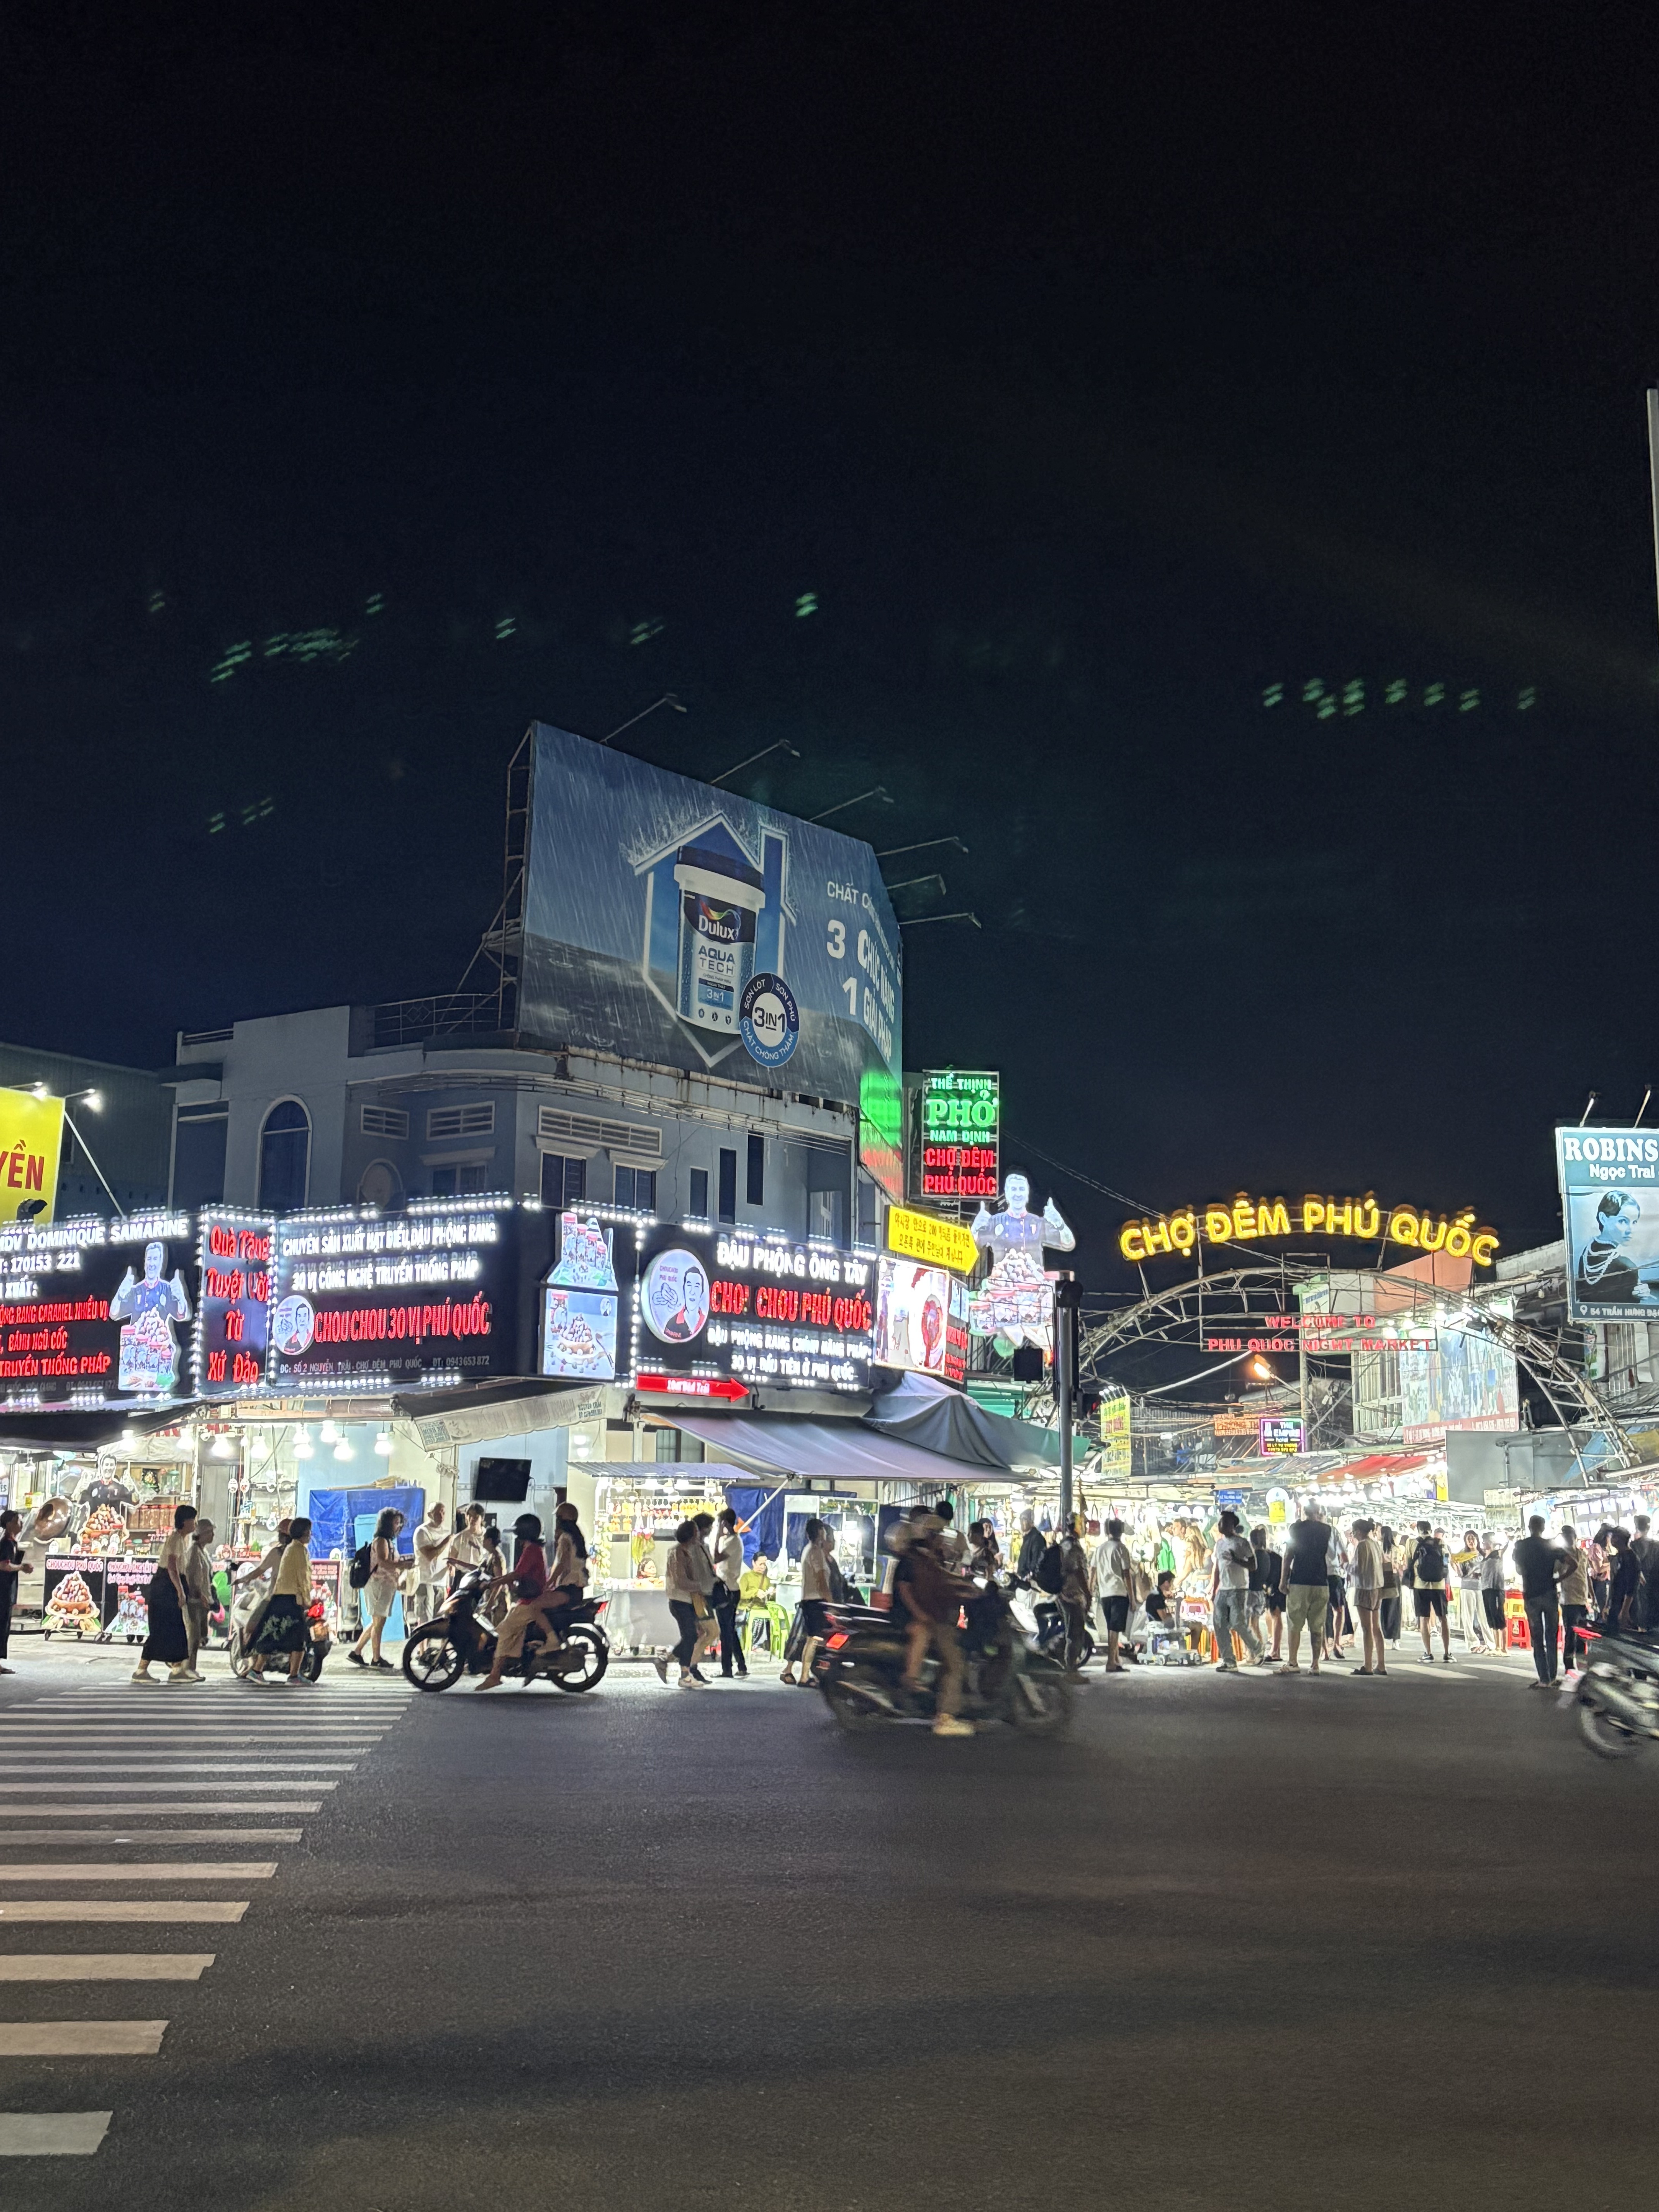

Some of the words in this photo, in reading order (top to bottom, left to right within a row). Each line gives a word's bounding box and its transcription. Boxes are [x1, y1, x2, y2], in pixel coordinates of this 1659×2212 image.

[699, 915, 735, 940] Dulux
[827, 920, 845, 959] 3
[698, 945, 735, 964] AQUA
[700, 957, 733, 975] TECH
[843, 977, 857, 1015] 1
[926, 1089, 999, 1127] PHỞ
[930, 1130, 957, 1142] NAM
[926, 1147, 957, 1170] CHỢ
[961, 1147, 993, 1167] ĐÊM
[1564, 1137, 1659, 1162] ROBINS
[925, 1171, 954, 1193] PHÚ
[958, 1168, 996, 1195] QUỐC
[1589, 1163, 1626, 1180] Ngọc
[27, 1226, 105, 1249] DOMINIQUE
[110, 1218, 188, 1241] SAMARINE
[469, 1223, 496, 1242] RANG
[1120, 1213, 1195, 1260] CHỢ
[1206, 1200, 1291, 1243] ĐÊM
[1303, 1199, 1380, 1238] PHÚ
[1390, 1214, 1499, 1266] QUỐC
[10, 1255, 52, 1273] 170153
[57, 1252, 80, 1269] 221
[753, 1247, 805, 1278] PHỘNG
[809, 1252, 840, 1281] ÔNG
[843, 1259, 868, 1285] TÂY
[39, 1303, 73, 1322] CARAMEL
[314, 1311, 349, 1342] CHOU
[350, 1309, 386, 1340] CHOU
[388, 1307, 405, 1339] 30
[408, 1306, 420, 1345] VỊ
[422, 1297, 450, 1336] PHÚ
[453, 1291, 489, 1340] QUỐC
[757, 1286, 798, 1321] CHOU
[802, 1287, 831, 1326] PHÚ
[835, 1289, 871, 1333] QUỐC
[1265, 1315, 1344, 1329] WELCOME
[1353, 1316, 1375, 1328] TO
[1208, 1339, 1241, 1351] PHU
[1248, 1338, 1295, 1352] QUOC
[1302, 1338, 1353, 1351] NIGHT
[1361, 1338, 1430, 1351] MARKET
[81, 1352, 111, 1374] PHÁP
[304, 1364, 307, 1372] 2
